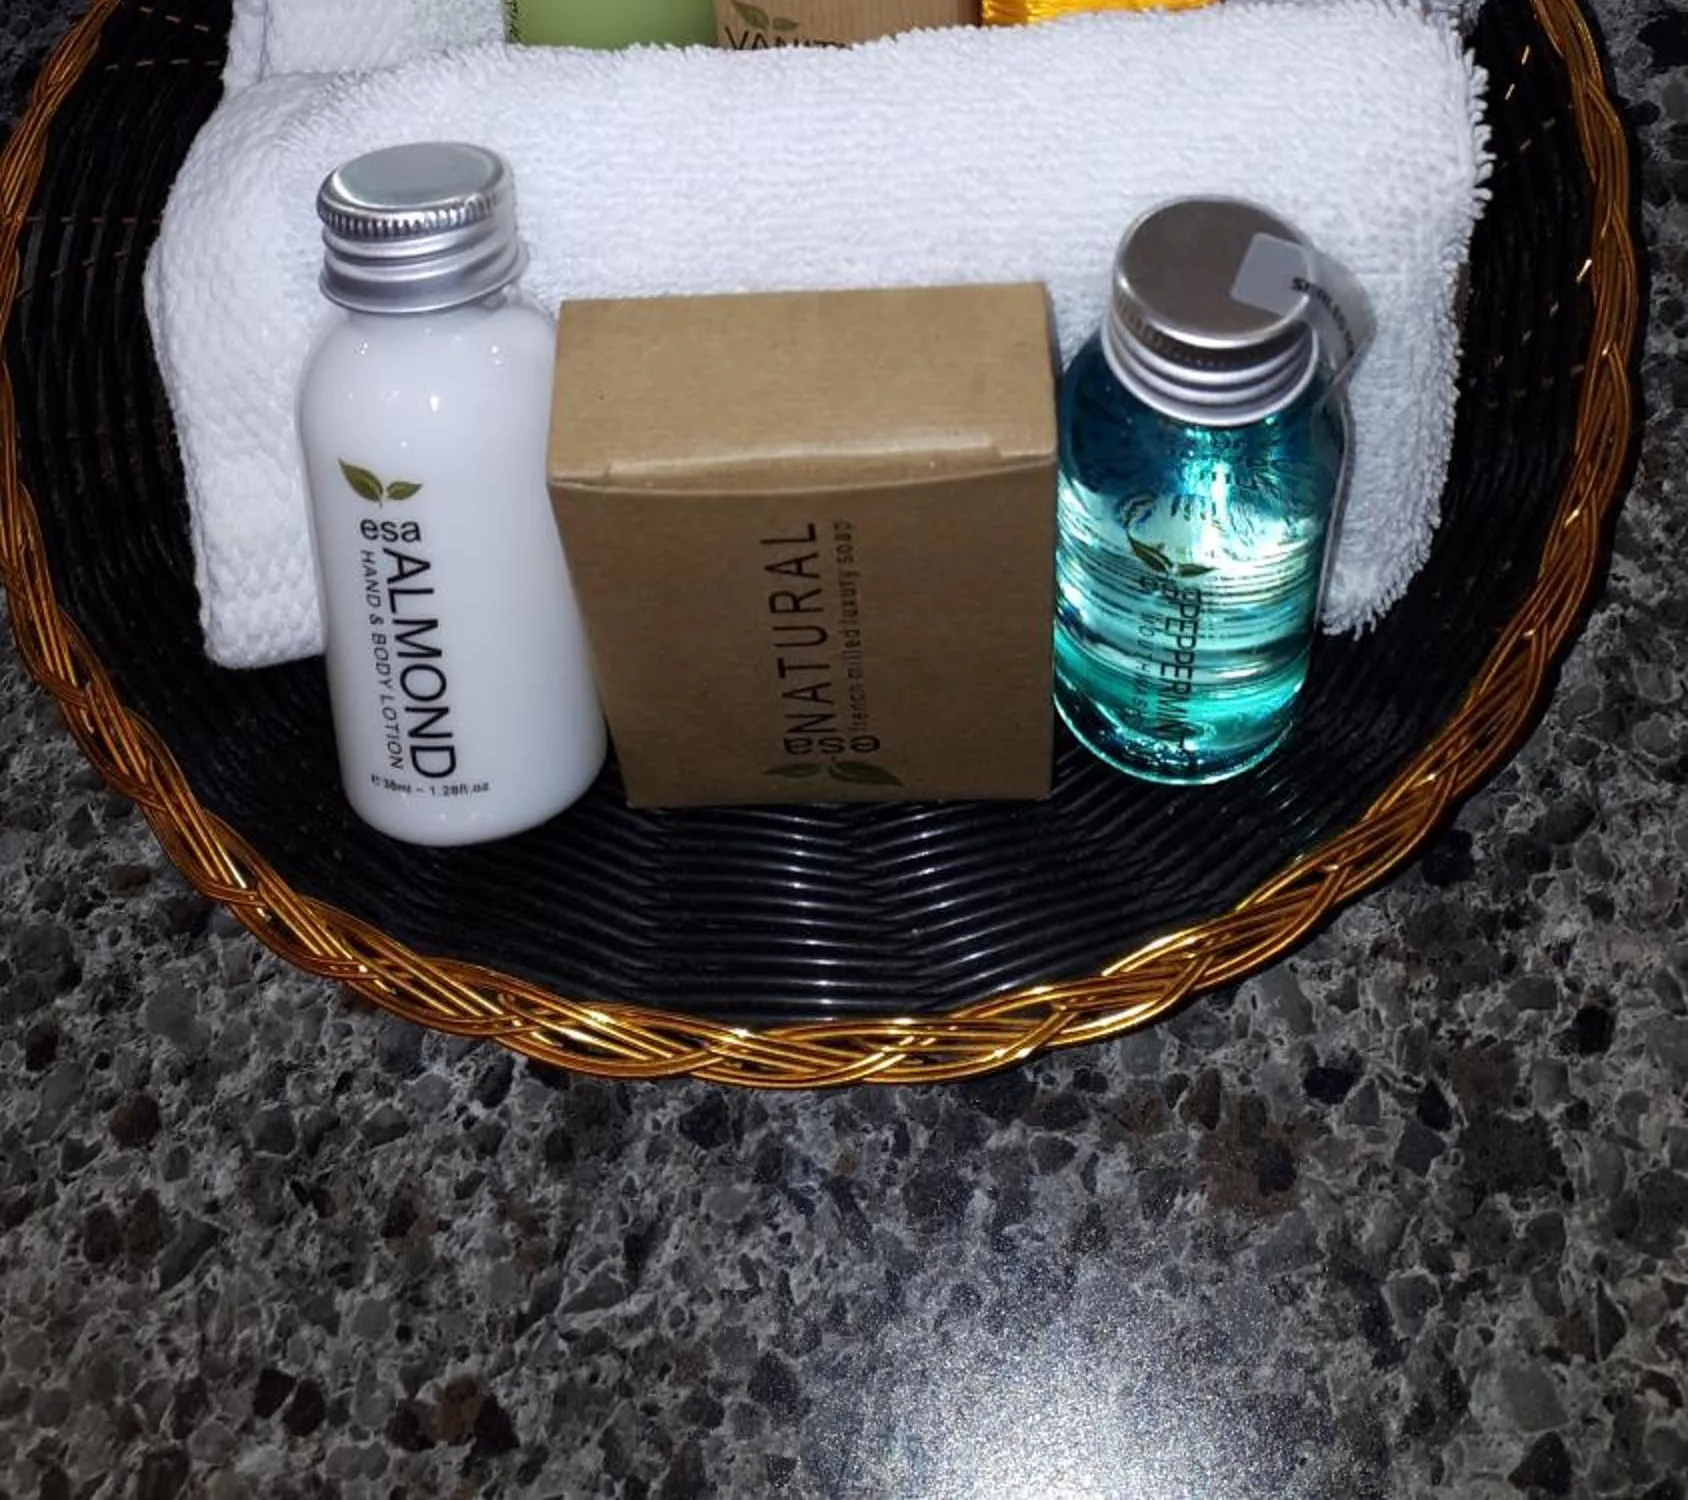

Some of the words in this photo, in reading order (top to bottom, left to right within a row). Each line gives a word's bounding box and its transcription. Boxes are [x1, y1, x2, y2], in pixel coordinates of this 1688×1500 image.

[360, 517, 421, 543] esa
[833, 520, 854, 565] soap
[361, 549, 383, 608] HAND
[837, 570, 862, 625] luxury
[759, 522, 838, 735] NATURAL
[840, 629, 863, 680] milled
[371, 631, 394, 690] BODY
[381, 546, 457, 779] ALMOND
[379, 694, 405, 771] LOTION
[783, 734, 882, 756] esa
